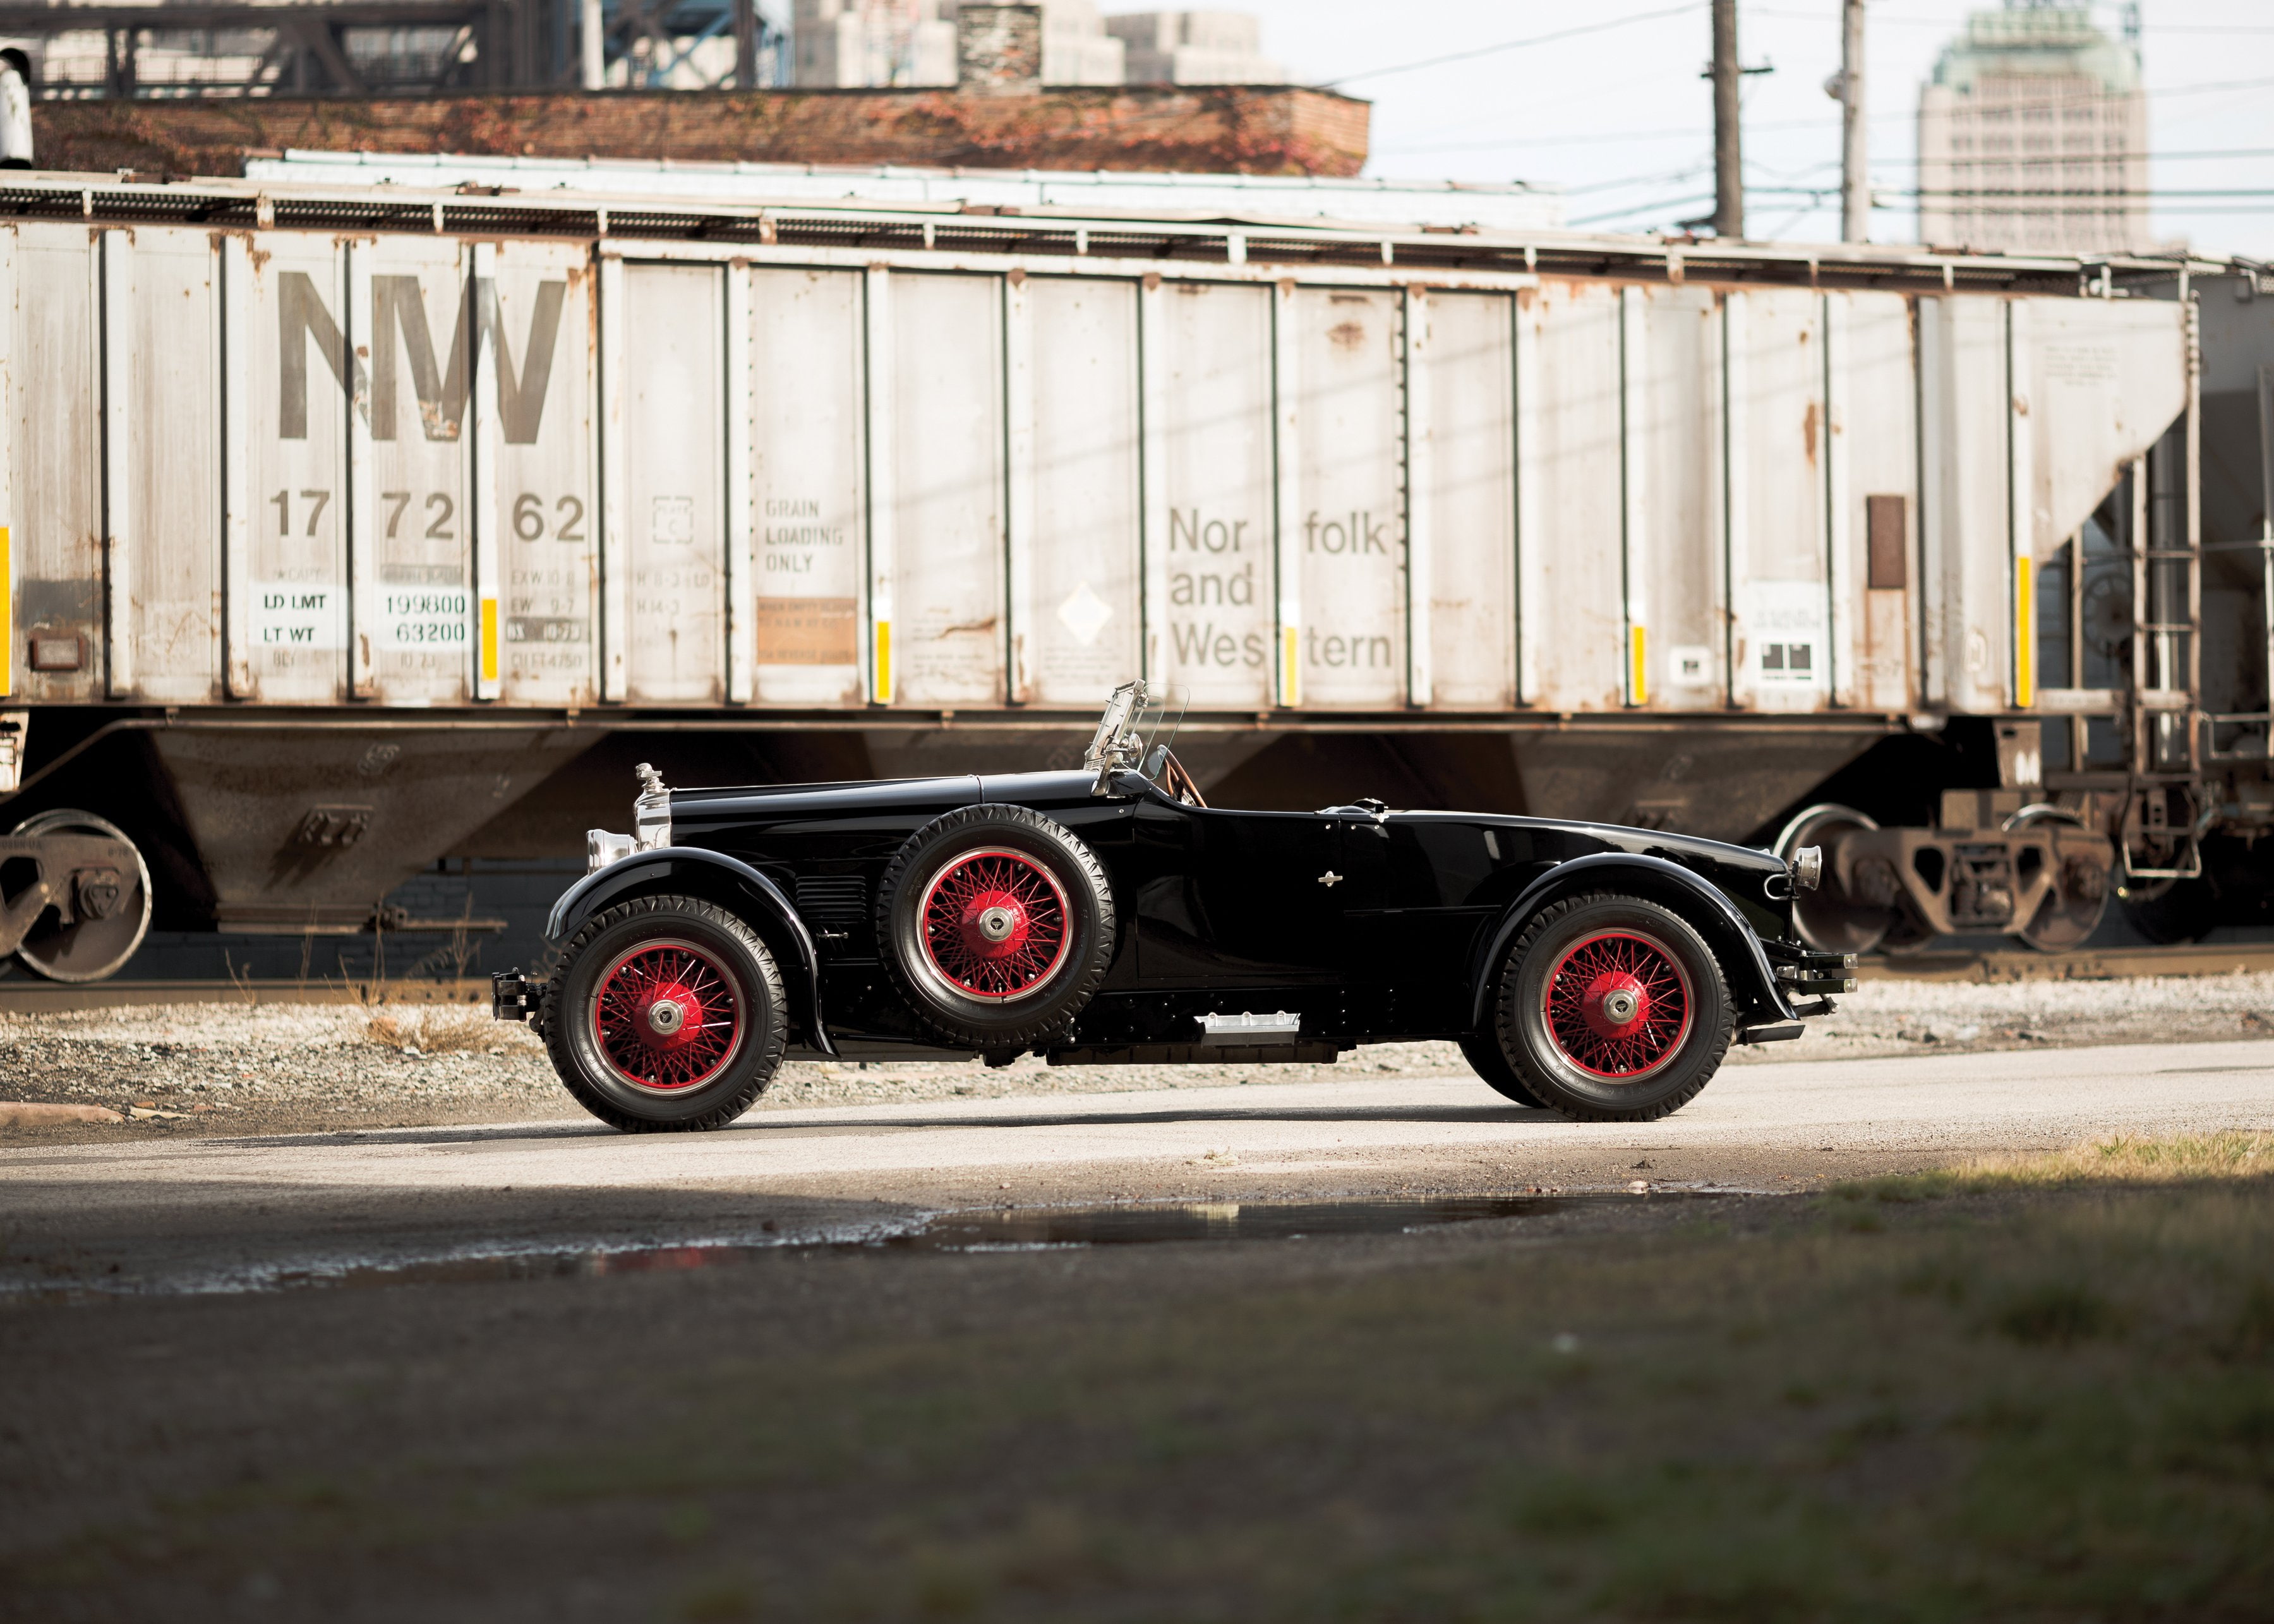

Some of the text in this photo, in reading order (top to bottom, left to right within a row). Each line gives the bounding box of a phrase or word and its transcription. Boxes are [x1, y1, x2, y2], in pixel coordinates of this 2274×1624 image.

[278, 271, 567, 445] NW
[766, 499, 819, 517] GRAIN
[766, 527, 843, 545] LOADING
[1169, 508, 1388, 554] Nor folk
[766, 554, 813, 572] ONLY
[1170, 562, 1254, 606] and
[263, 594, 466, 615] LD LMT 199800
[263, 622, 466, 642] LT WT 63200
[1172, 623, 1265, 668] Wes
[1305, 626, 1391, 668] tern
